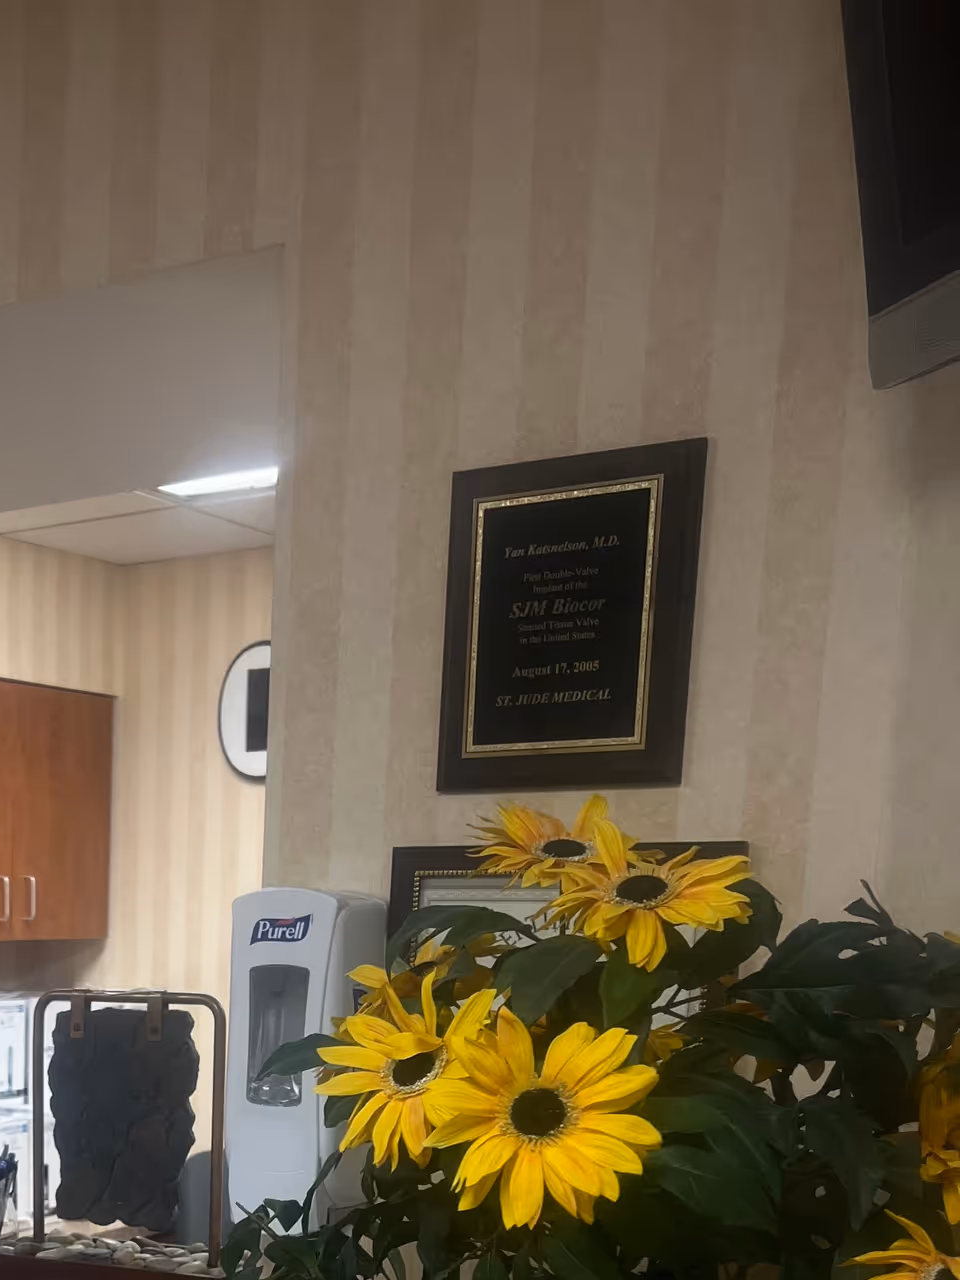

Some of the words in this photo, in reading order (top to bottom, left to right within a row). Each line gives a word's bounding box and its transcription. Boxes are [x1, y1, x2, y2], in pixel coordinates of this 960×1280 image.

[503, 546, 525, 558] Yan
[527, 540, 589, 556] Katsnelson,
[592, 535, 620, 548] M.D.
[511, 600, 548, 618] SJM
[551, 598, 607, 615] Biocor
[576, 617, 600, 627] Valve
[512, 665, 551, 679] August
[554, 662, 570, 674] 17,
[573, 659, 600, 673] 2005
[495, 695, 513, 707] ST.
[515, 692, 550, 706] JUDE
[551, 688, 612, 703] MEDICAL
[257, 921, 305, 939] Purell
